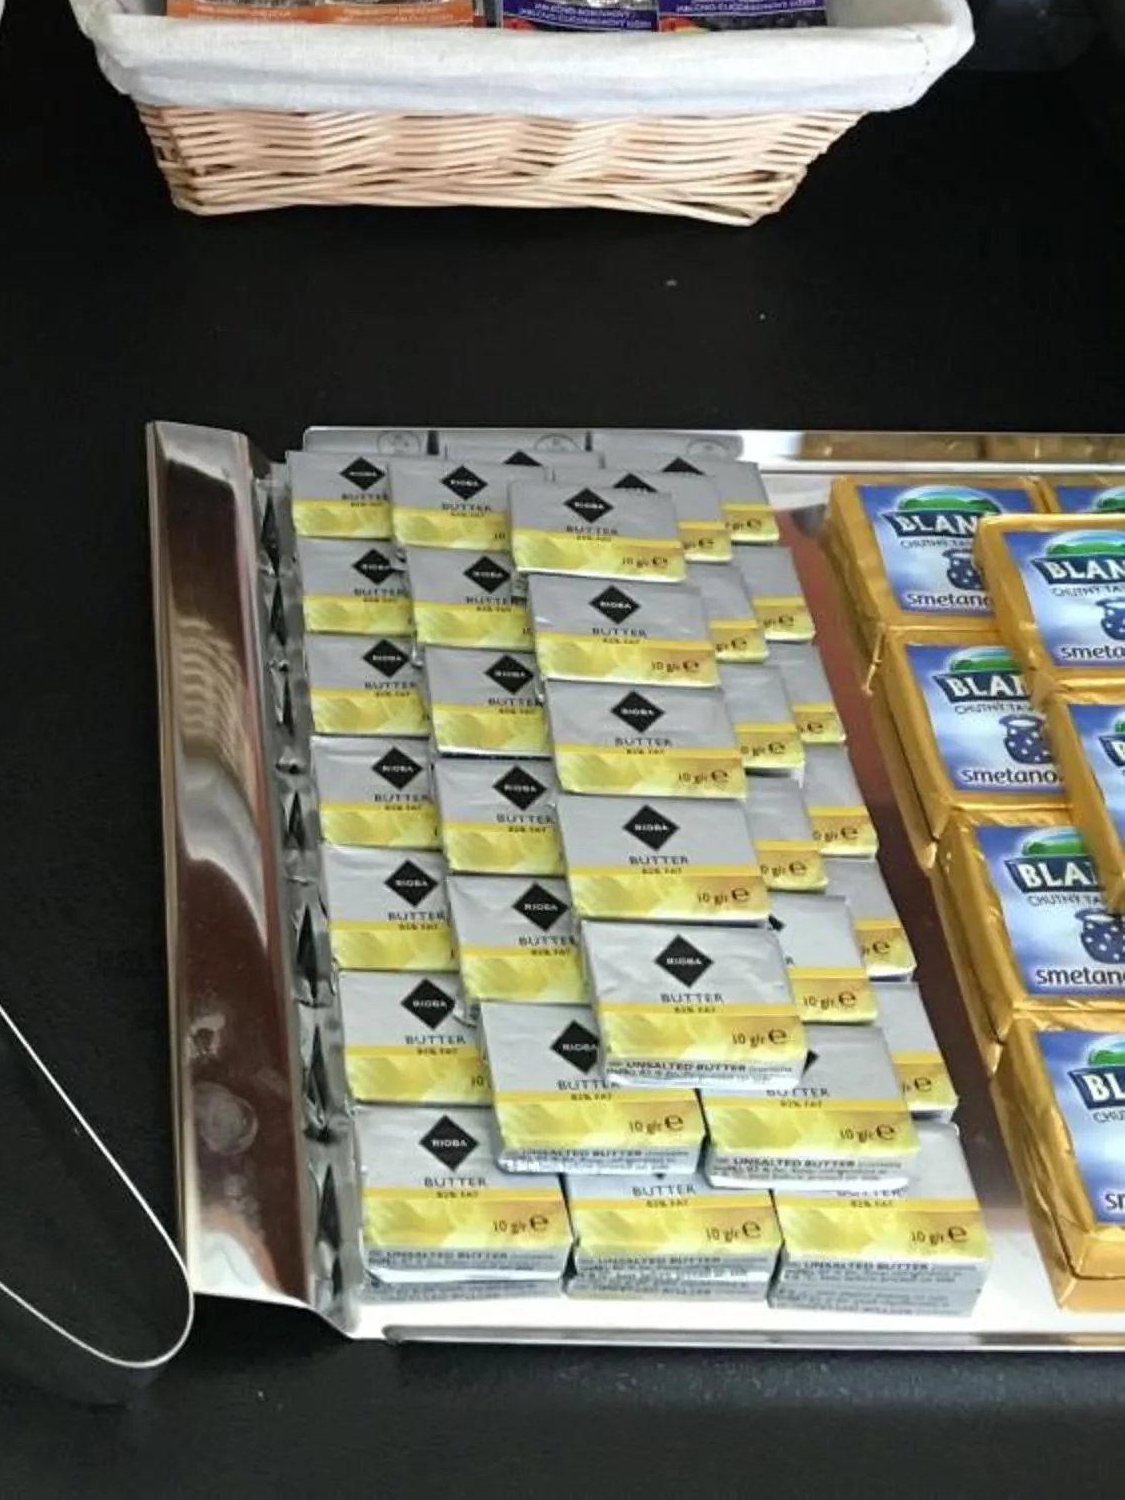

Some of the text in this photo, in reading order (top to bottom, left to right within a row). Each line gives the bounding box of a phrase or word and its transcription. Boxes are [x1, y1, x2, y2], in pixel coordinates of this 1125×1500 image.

[566, 525, 618, 535] BUTTER
[898, 514, 979, 536] BLAN
[1043, 559, 1125, 579] BLAN
[592, 627, 647, 638] BUTTER
[1061, 644, 1125, 660] smeta
[364, 681, 417, 690] BUTTER
[614, 738, 673, 748] BUTTER
[962, 768, 1063, 785] smetano
[375, 794, 428, 803] BUTTER
[496, 814, 554, 824] BUTTER
[634, 823, 669, 833] RIOBA
[629, 855, 689, 866] BUTTER
[388, 912, 446, 921] BUTTER
[518, 937, 576, 946] BUTTER
[666, 956, 703, 966] RIOBA
[1036, 967, 1125, 985] smetan
[660, 993, 724, 1004] BUTTER
[405, 1035, 466, 1045] BUTTER
[695, 1063, 747, 1073] BUTTER
[557, 1079, 620, 1091] BUTTER
[628, 1120, 645, 1133] 10
[431, 1139, 468, 1148] RIOBA
[804, 1160, 855, 1168] BUTTER
[424, 1177, 488, 1187] BUTTER
[632, 1185, 696, 1197] BUTTER
[492, 1221, 507, 1232] 10
[705, 1226, 721, 1240] 10
[911, 1230, 927, 1243] 10
